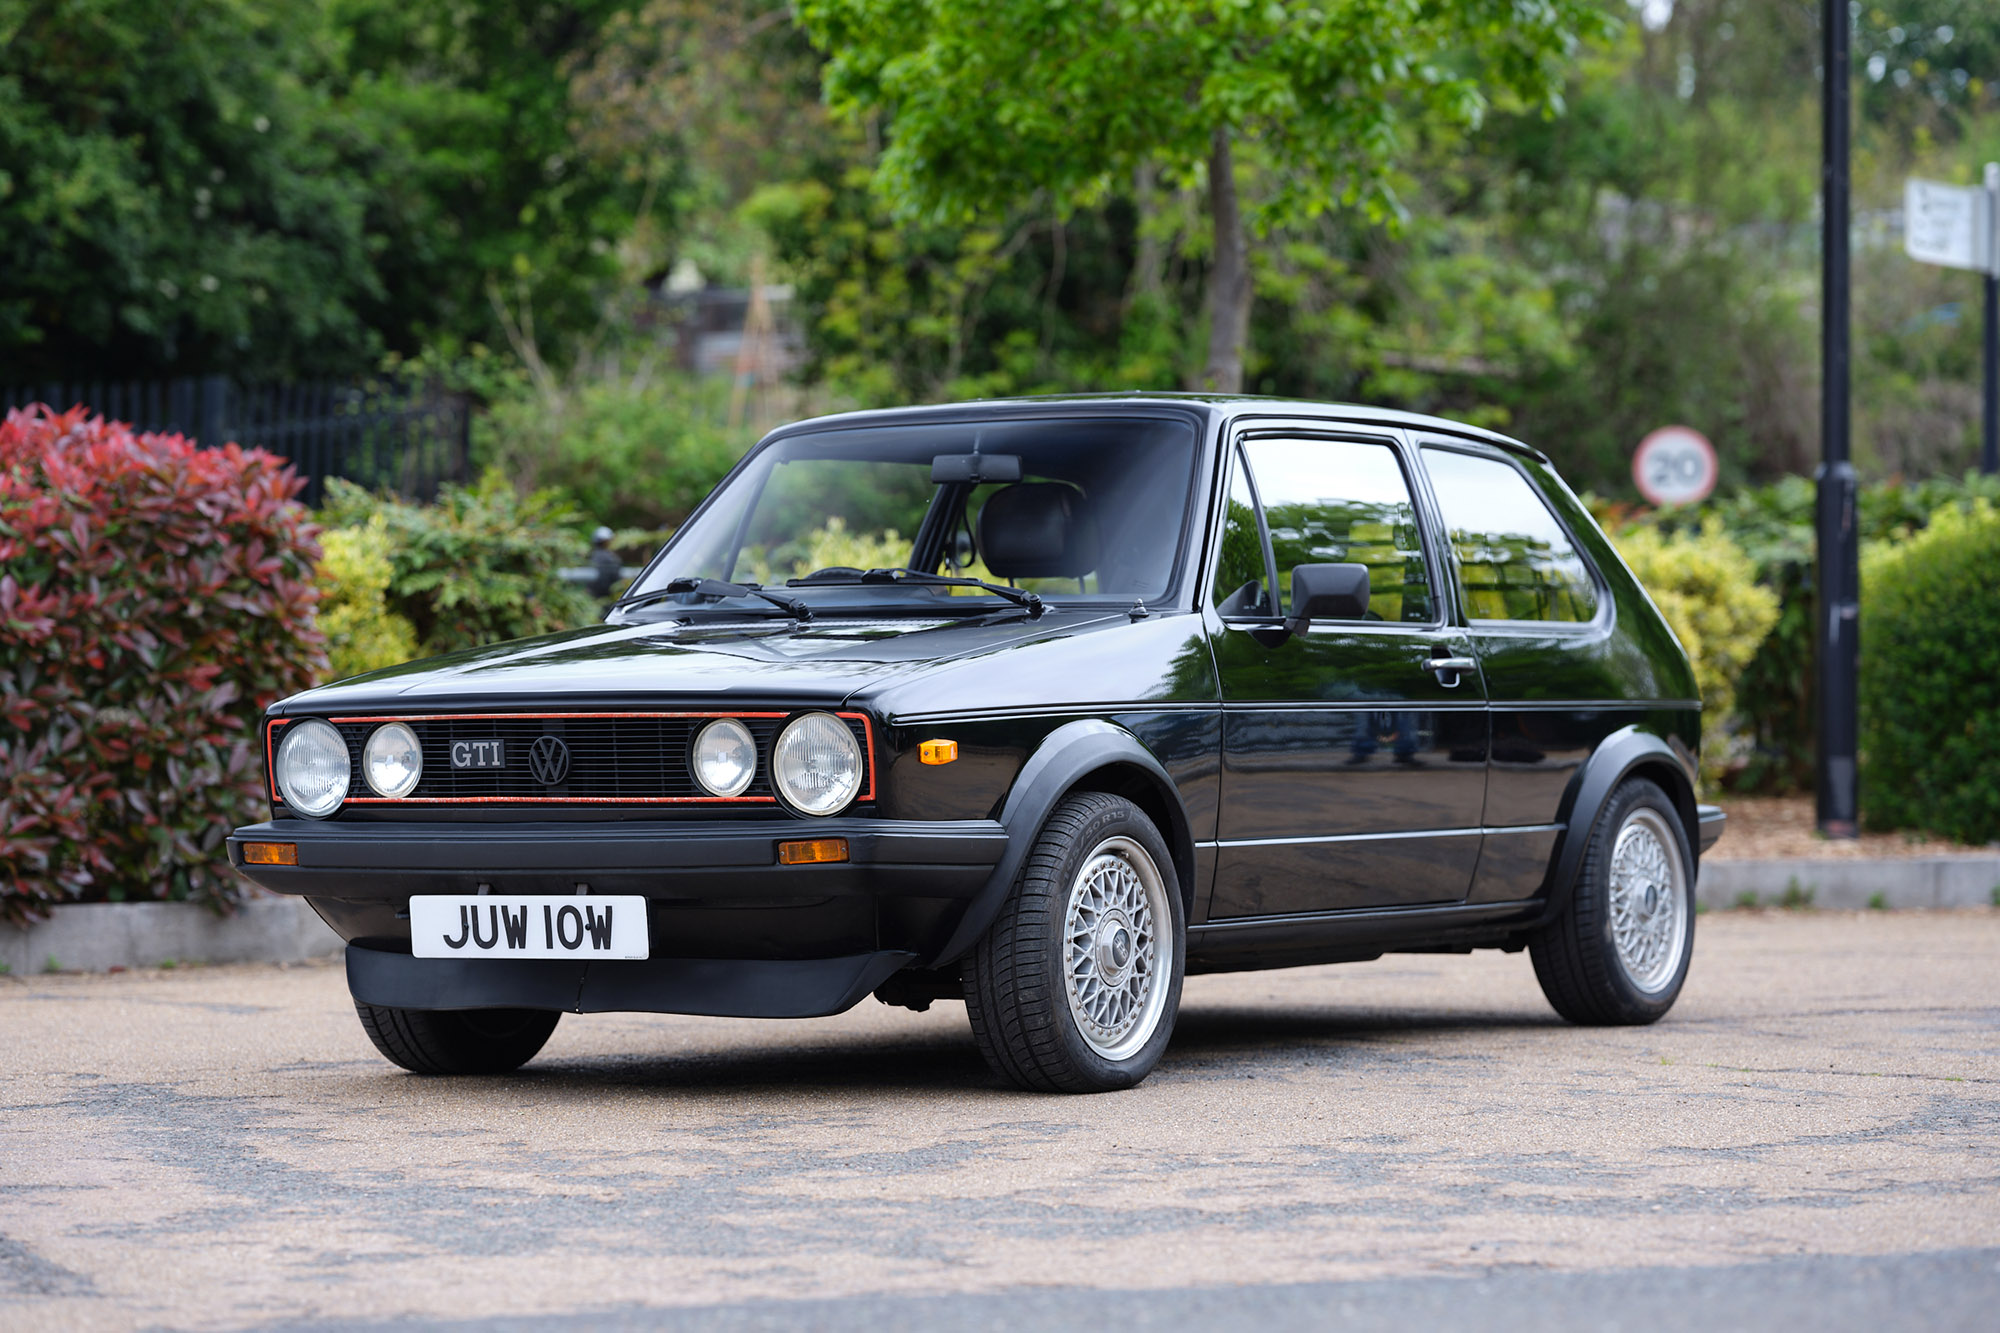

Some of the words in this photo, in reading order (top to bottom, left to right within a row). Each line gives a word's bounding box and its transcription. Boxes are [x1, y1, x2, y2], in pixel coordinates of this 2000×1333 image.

[1650, 449, 1703, 487] 20
[452, 742, 500, 767] GTI
[443, 905, 527, 949] JUW
